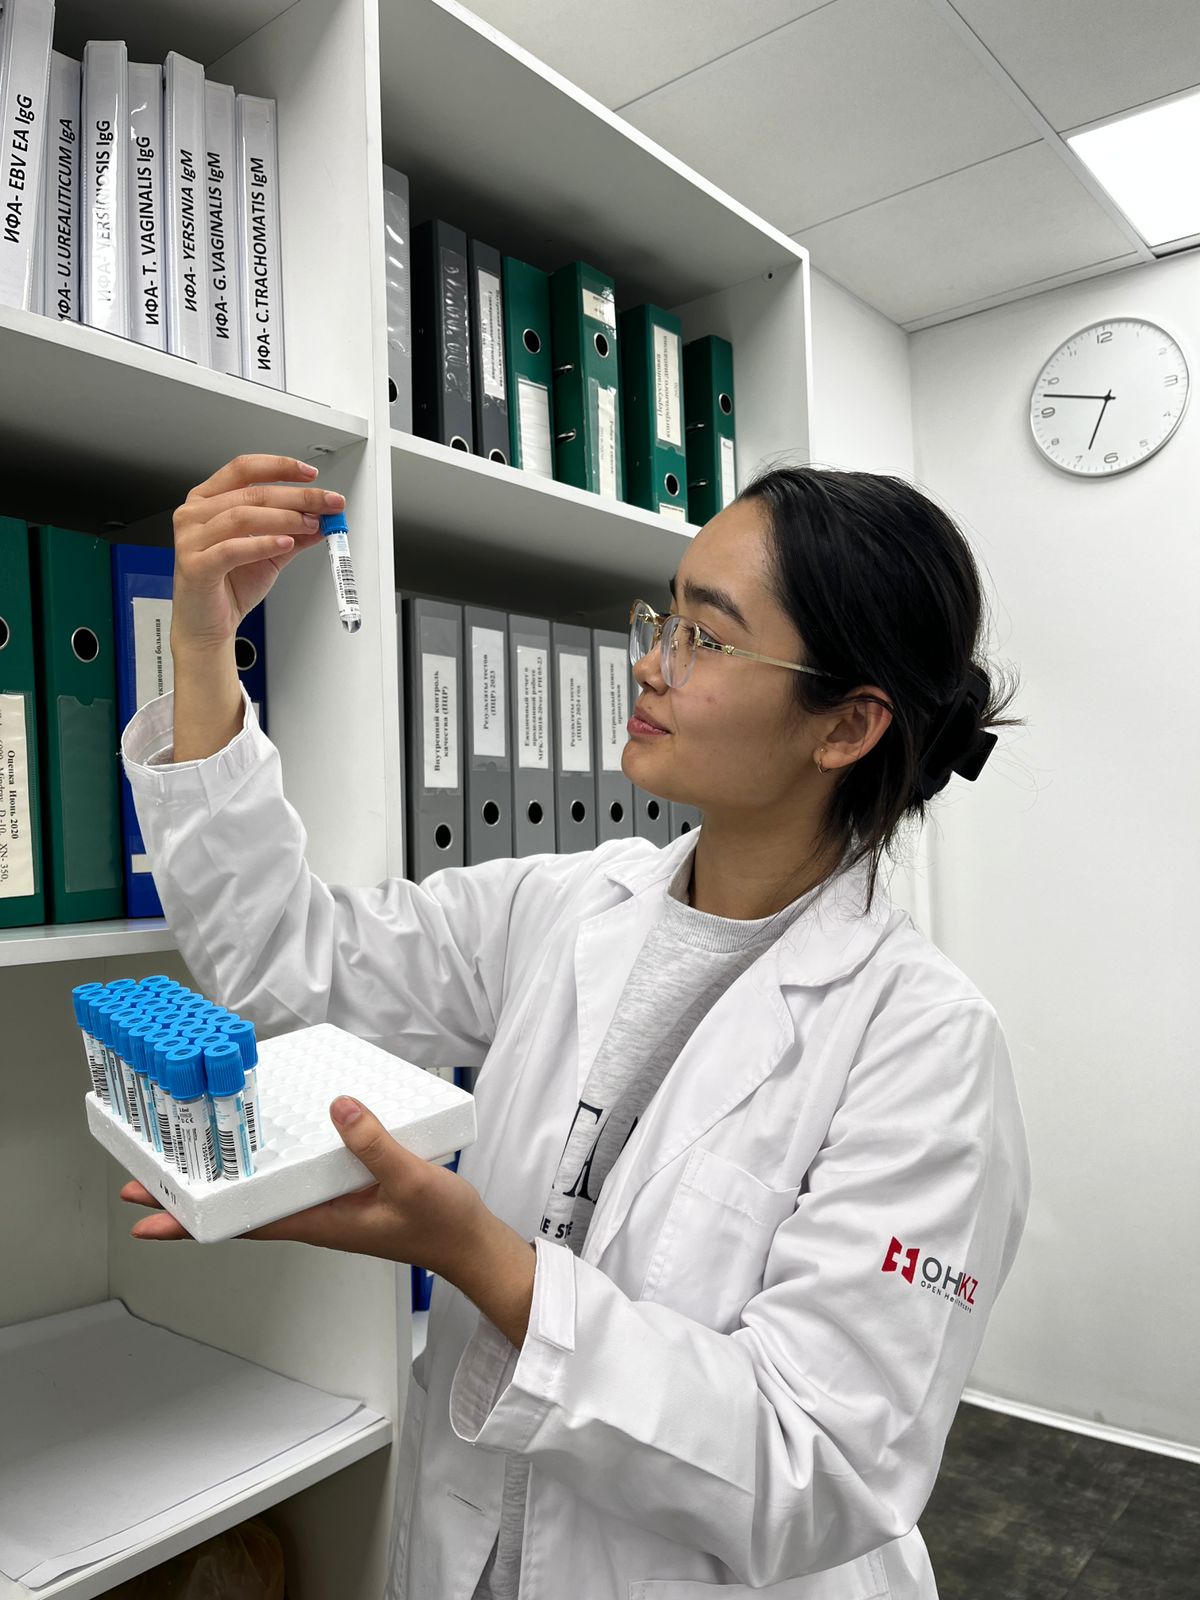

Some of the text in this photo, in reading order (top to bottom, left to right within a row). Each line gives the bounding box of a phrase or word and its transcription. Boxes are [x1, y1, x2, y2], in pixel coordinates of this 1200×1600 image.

[59, 119, 76, 144] IgA
[96, 120, 114, 145] IgG
[4, 94, 35, 243] ИФА- EBV EA IgG
[58, 145, 72, 278] U.UREALITICUM
[136, 136, 159, 325] ИФА- T. VAGINALIS IgG
[180, 149, 198, 313] ИФА- YERSINIA IgM
[207, 152, 230, 339] ИФА- G.VAGINALIS IgM
[250, 157, 271, 370] ИФА- C.TRACHOMATIS IgM
[1096, 331, 1113, 344] 12
[1164, 374, 1179, 387] 3
[1041, 407, 1056, 418] 9
[1104, 452, 1119, 464] 6
[154, 619, 164, 697] екционная больница
[433, 671, 441, 772] Внутренний контроль
[441, 686, 449, 715] (ПЦР)
[7, 750, 19, 839] Оценка Июнь 2020
[920, 1280, 942, 1296] OPEN
[922, 1257, 979, 1305] OHKZ
